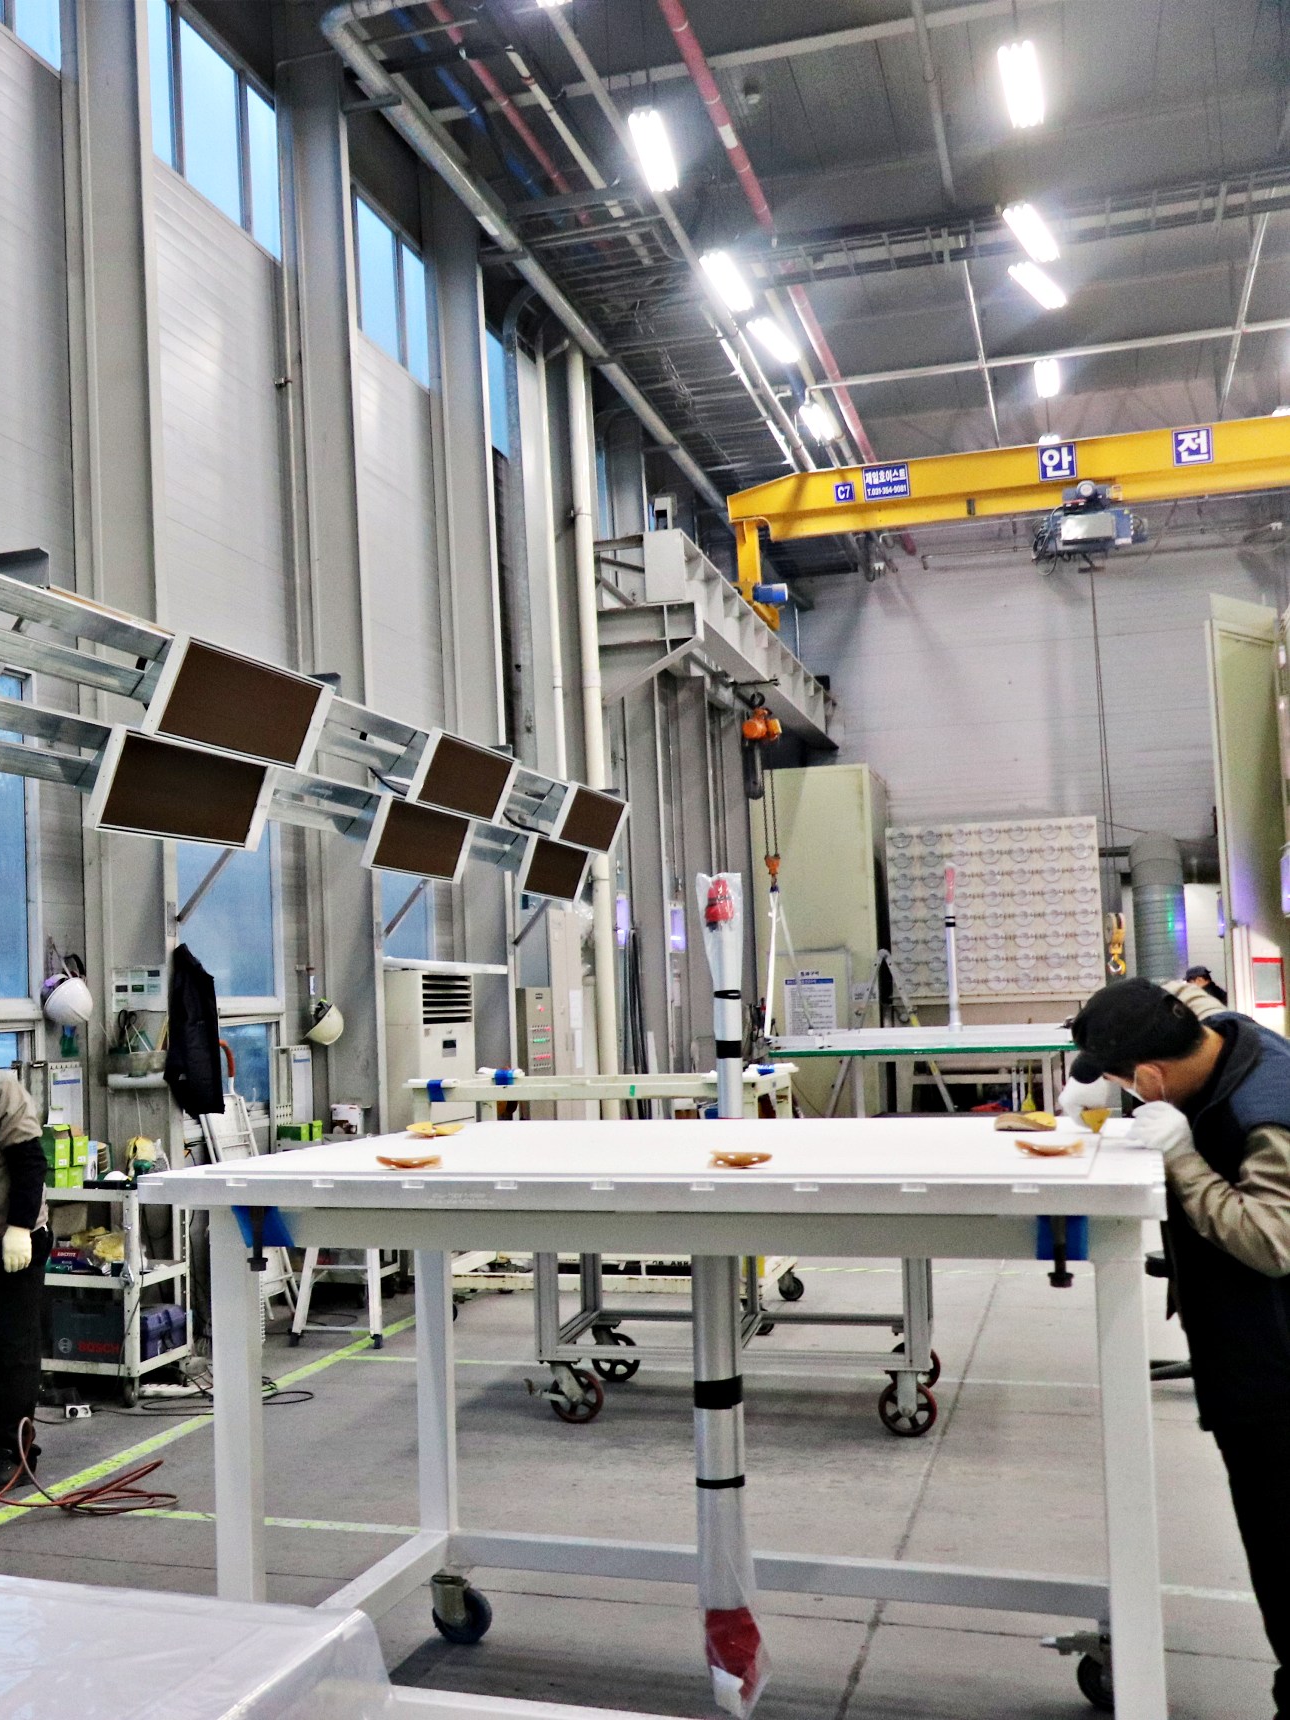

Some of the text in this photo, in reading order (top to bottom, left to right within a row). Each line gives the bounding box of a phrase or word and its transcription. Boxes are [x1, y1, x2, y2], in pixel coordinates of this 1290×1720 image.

[1041, 429, 1209, 477] 안 전
[837, 485, 851, 500] C7
[78, 1342, 119, 1353] BOSCH
